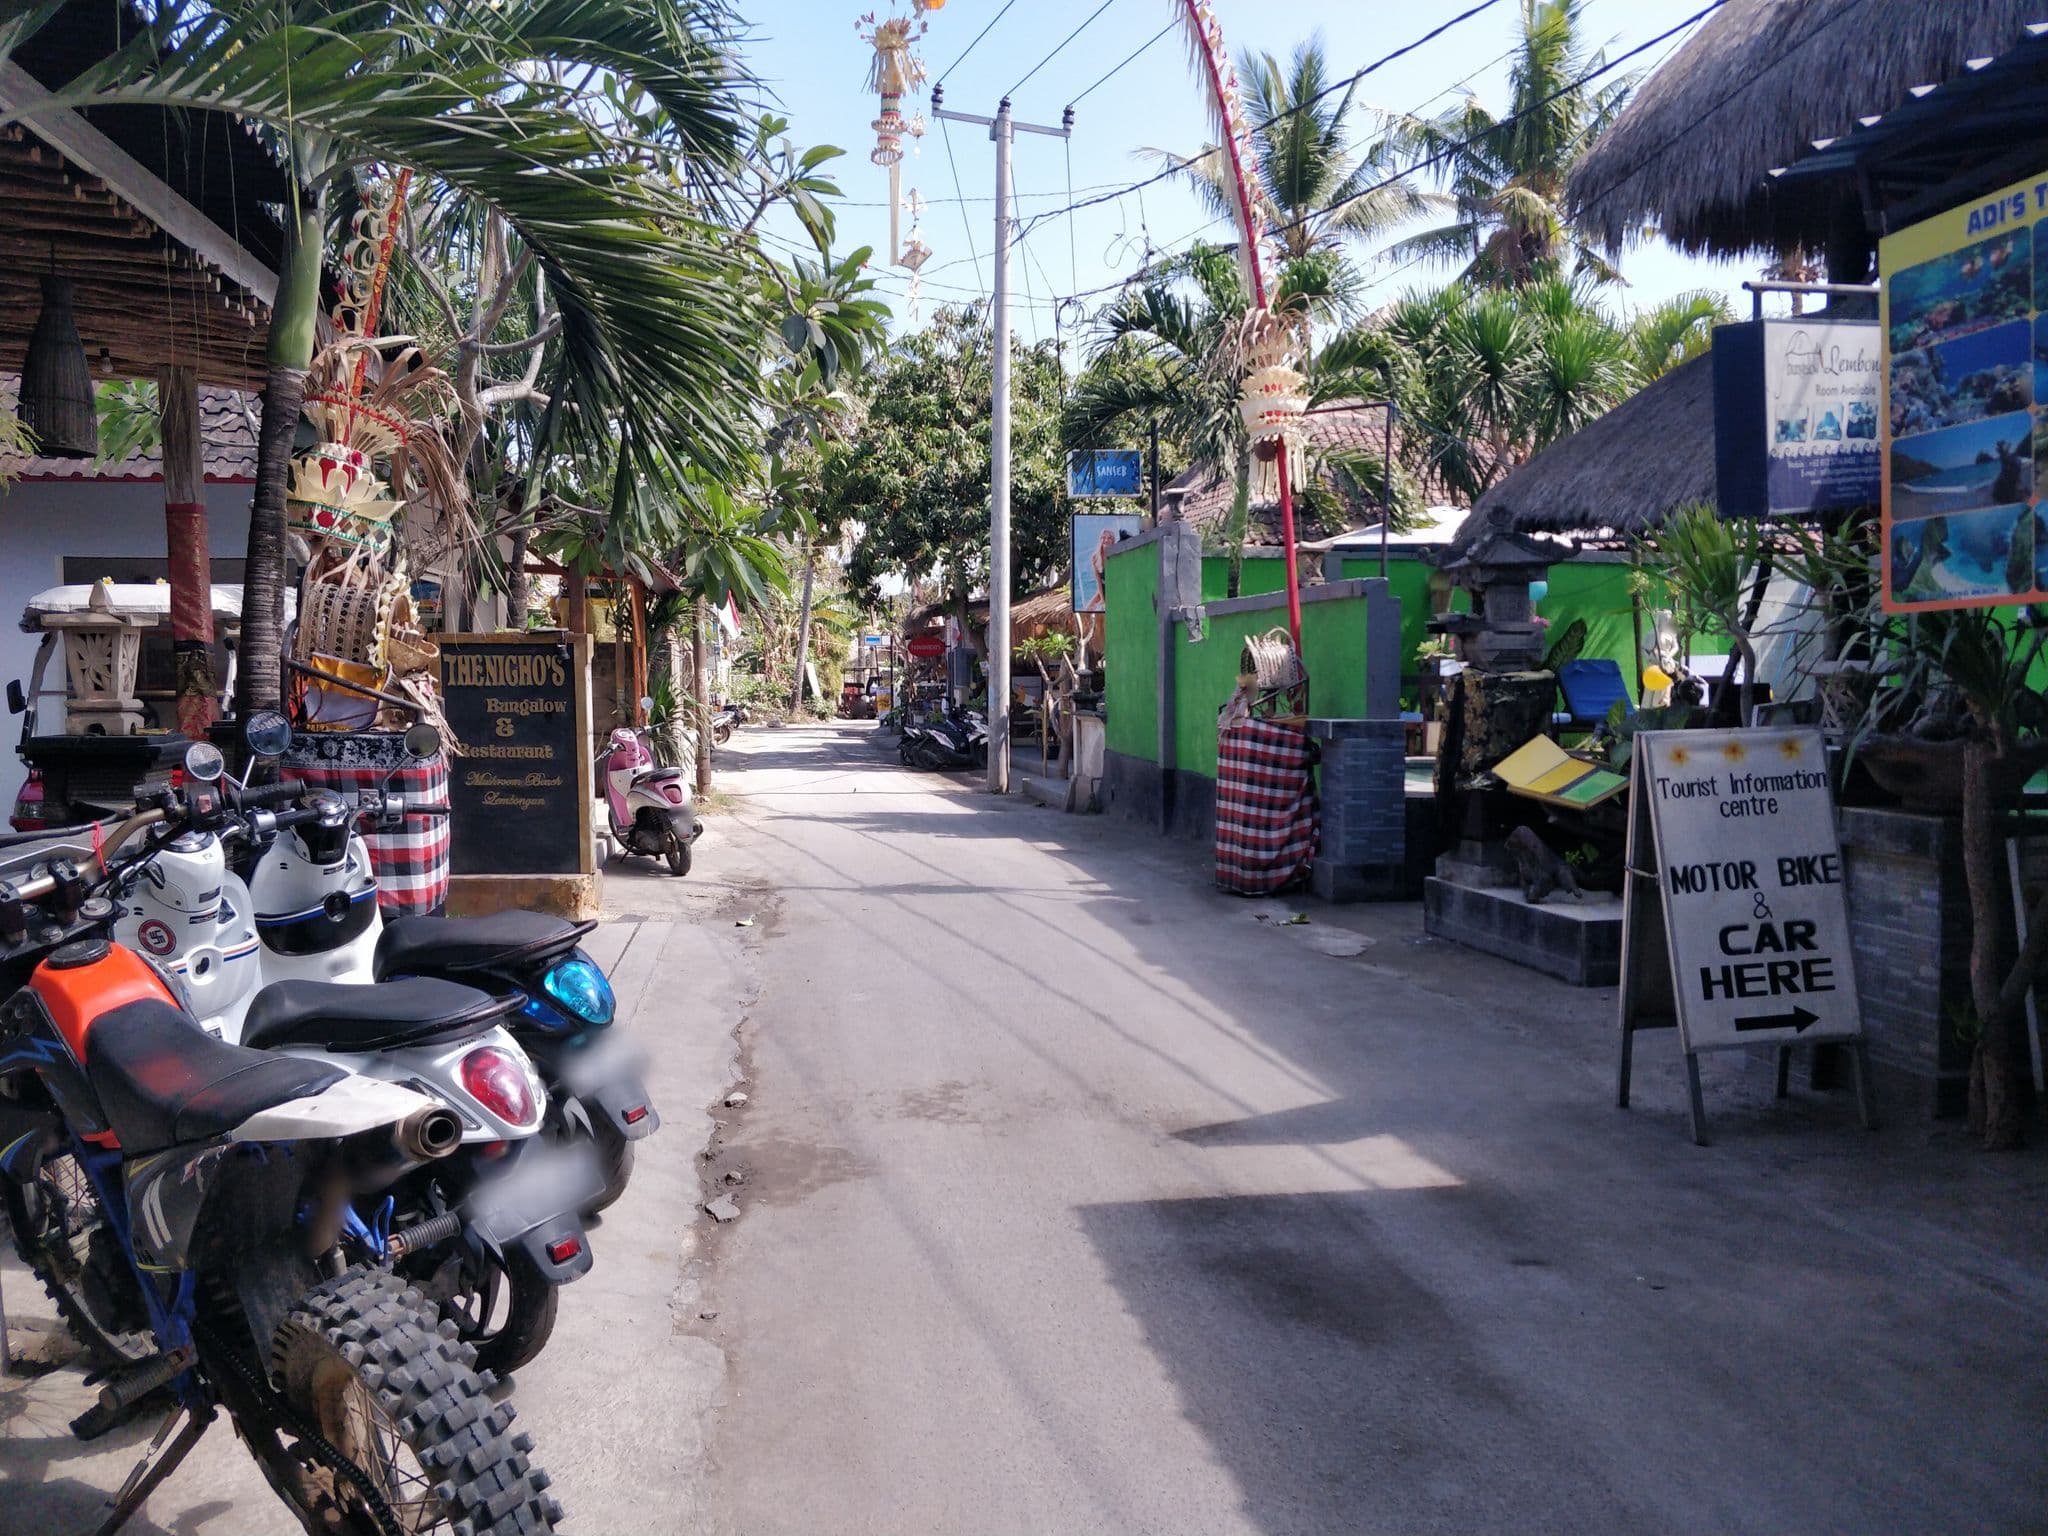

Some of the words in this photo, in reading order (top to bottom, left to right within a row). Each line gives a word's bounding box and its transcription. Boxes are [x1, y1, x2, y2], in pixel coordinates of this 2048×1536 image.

[1967, 191, 2026, 236] ADI'S
[1823, 345, 1882, 378] Lembon
[1816, 384, 1838, 396] Room
[495, 717, 515, 737] &
[456, 743, 554, 759] Restaurant
[1657, 776, 1719, 799] Tourist
[1729, 770, 1827, 794] Information
[1720, 797, 1778, 818] centre
[1670, 861, 1759, 894] MOTOR
[1777, 853, 1842, 887] BIKE
[1753, 892, 1773, 919] &
[1718, 920, 1818, 956] CAR
[1700, 957, 1836, 1001] HERE
